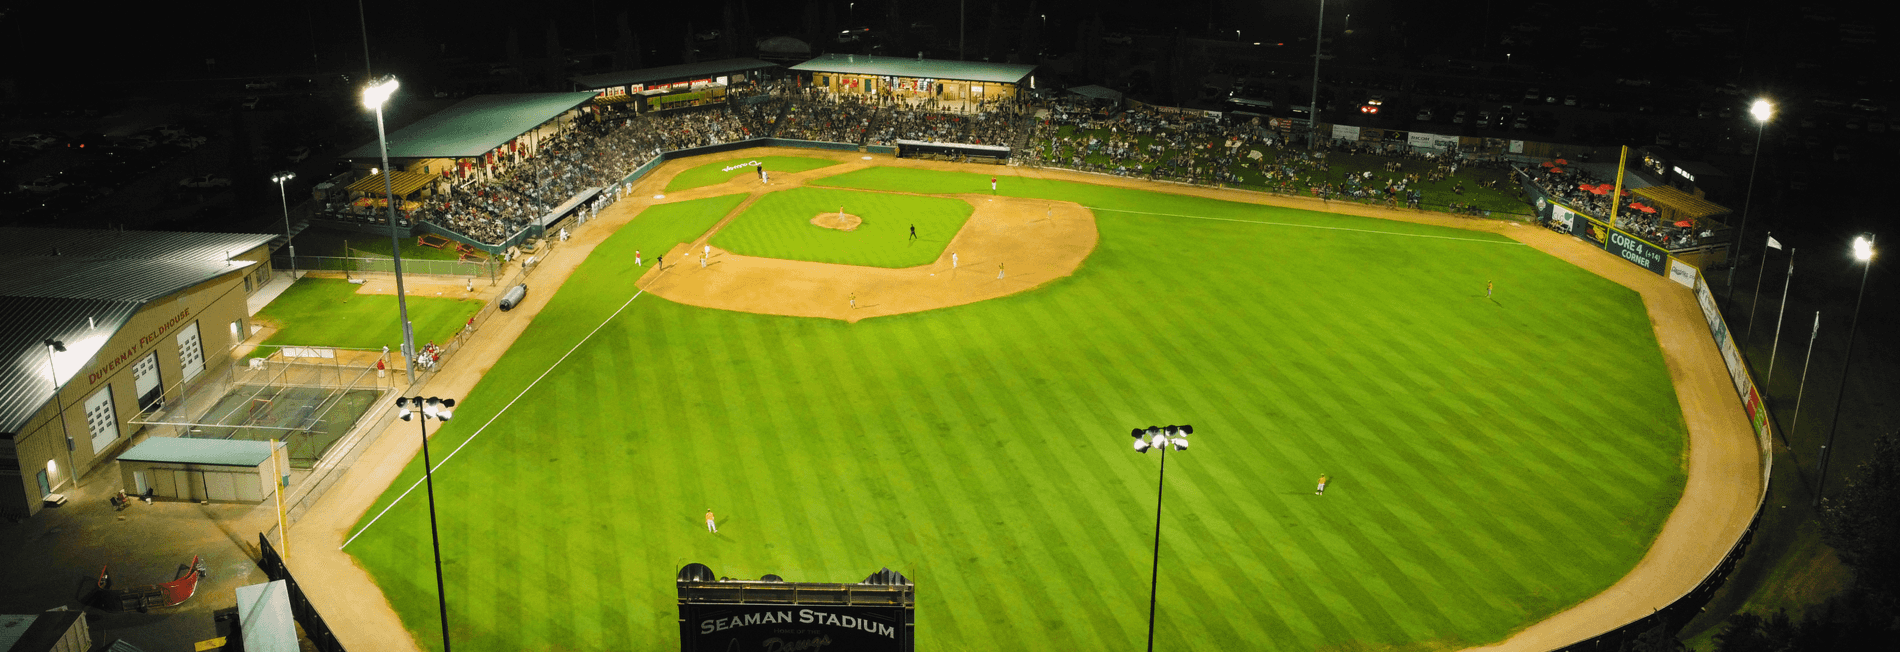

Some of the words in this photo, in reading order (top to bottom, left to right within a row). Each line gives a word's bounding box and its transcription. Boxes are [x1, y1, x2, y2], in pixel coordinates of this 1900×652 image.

[1611, 232, 1636, 252] CORE
[1636, 244, 1643, 255] 4
[1645, 249, 1661, 262] (+14)
[1621, 249, 1650, 268] CORNER
[88, 344, 137, 385] DUVERNAY
[139, 307, 190, 349] FIELDHOUSE
[700, 610, 793, 635] SEAMAN
[799, 609, 895, 639] STADIUM
